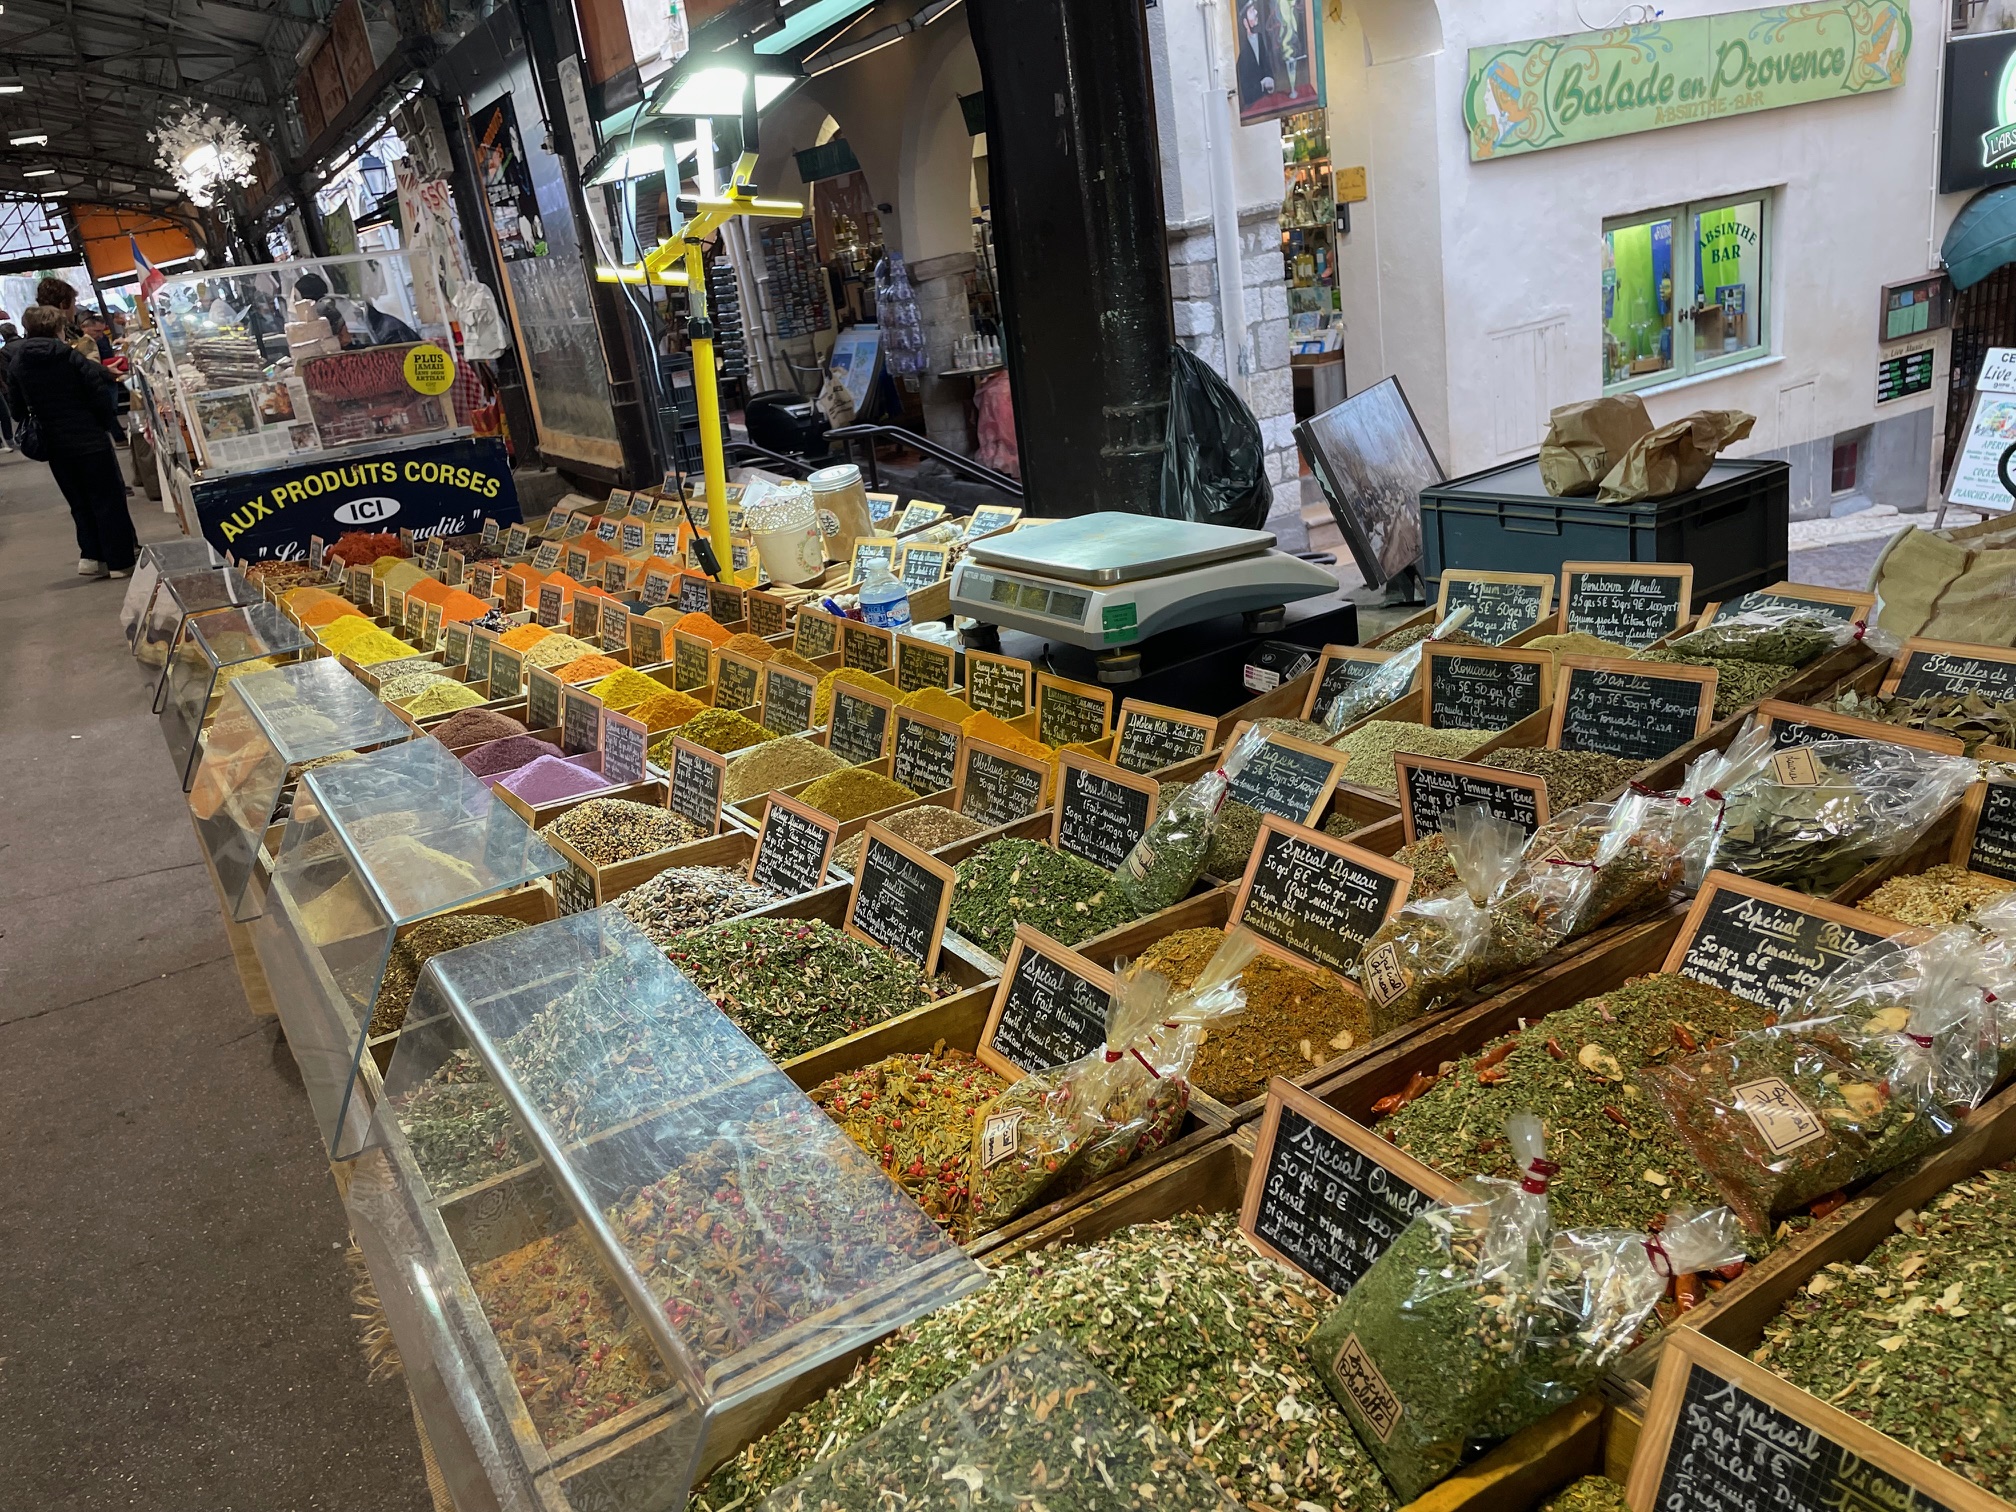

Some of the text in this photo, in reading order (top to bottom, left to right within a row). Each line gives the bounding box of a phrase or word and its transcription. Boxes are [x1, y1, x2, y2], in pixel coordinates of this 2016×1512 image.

[1553, 38, 1845, 124] Balade en Provence
[1698, 221, 1758, 252] ABSINTHE
[1711, 244, 1741, 264] BAR
[413, 353, 444, 363] PLUS
[1984, 364, 2012, 382] Live
[219, 461, 500, 544] AUX PRODUITS CORSES
[349, 500, 385, 521] ICI
[413, 514, 467, 542] ualité
[1922, 652, 2008, 682] Feuilles de
[1459, 681, 1471, 694] 5€
[1507, 685, 1523, 698] 9€
[1494, 785, 1507, 800] de
[1990, 789, 2011, 807] 50
[1277, 834, 1378, 890] Spécial Agneau
[1293, 867, 1312, 883] 8€
[1311, 877, 1331, 893] 100
[1350, 893, 1378, 913] 15€
[1722, 898, 1805, 937] Spécial
[1746, 952, 1773, 971] 8€
[1758, 937, 1825, 971] (maison)
[1021, 951, 1066, 991] Spécial
[1289, 1124, 1363, 1182] Spécial
[1324, 1181, 1349, 1212] 8€
[1704, 1378, 1822, 1461] Spécial
